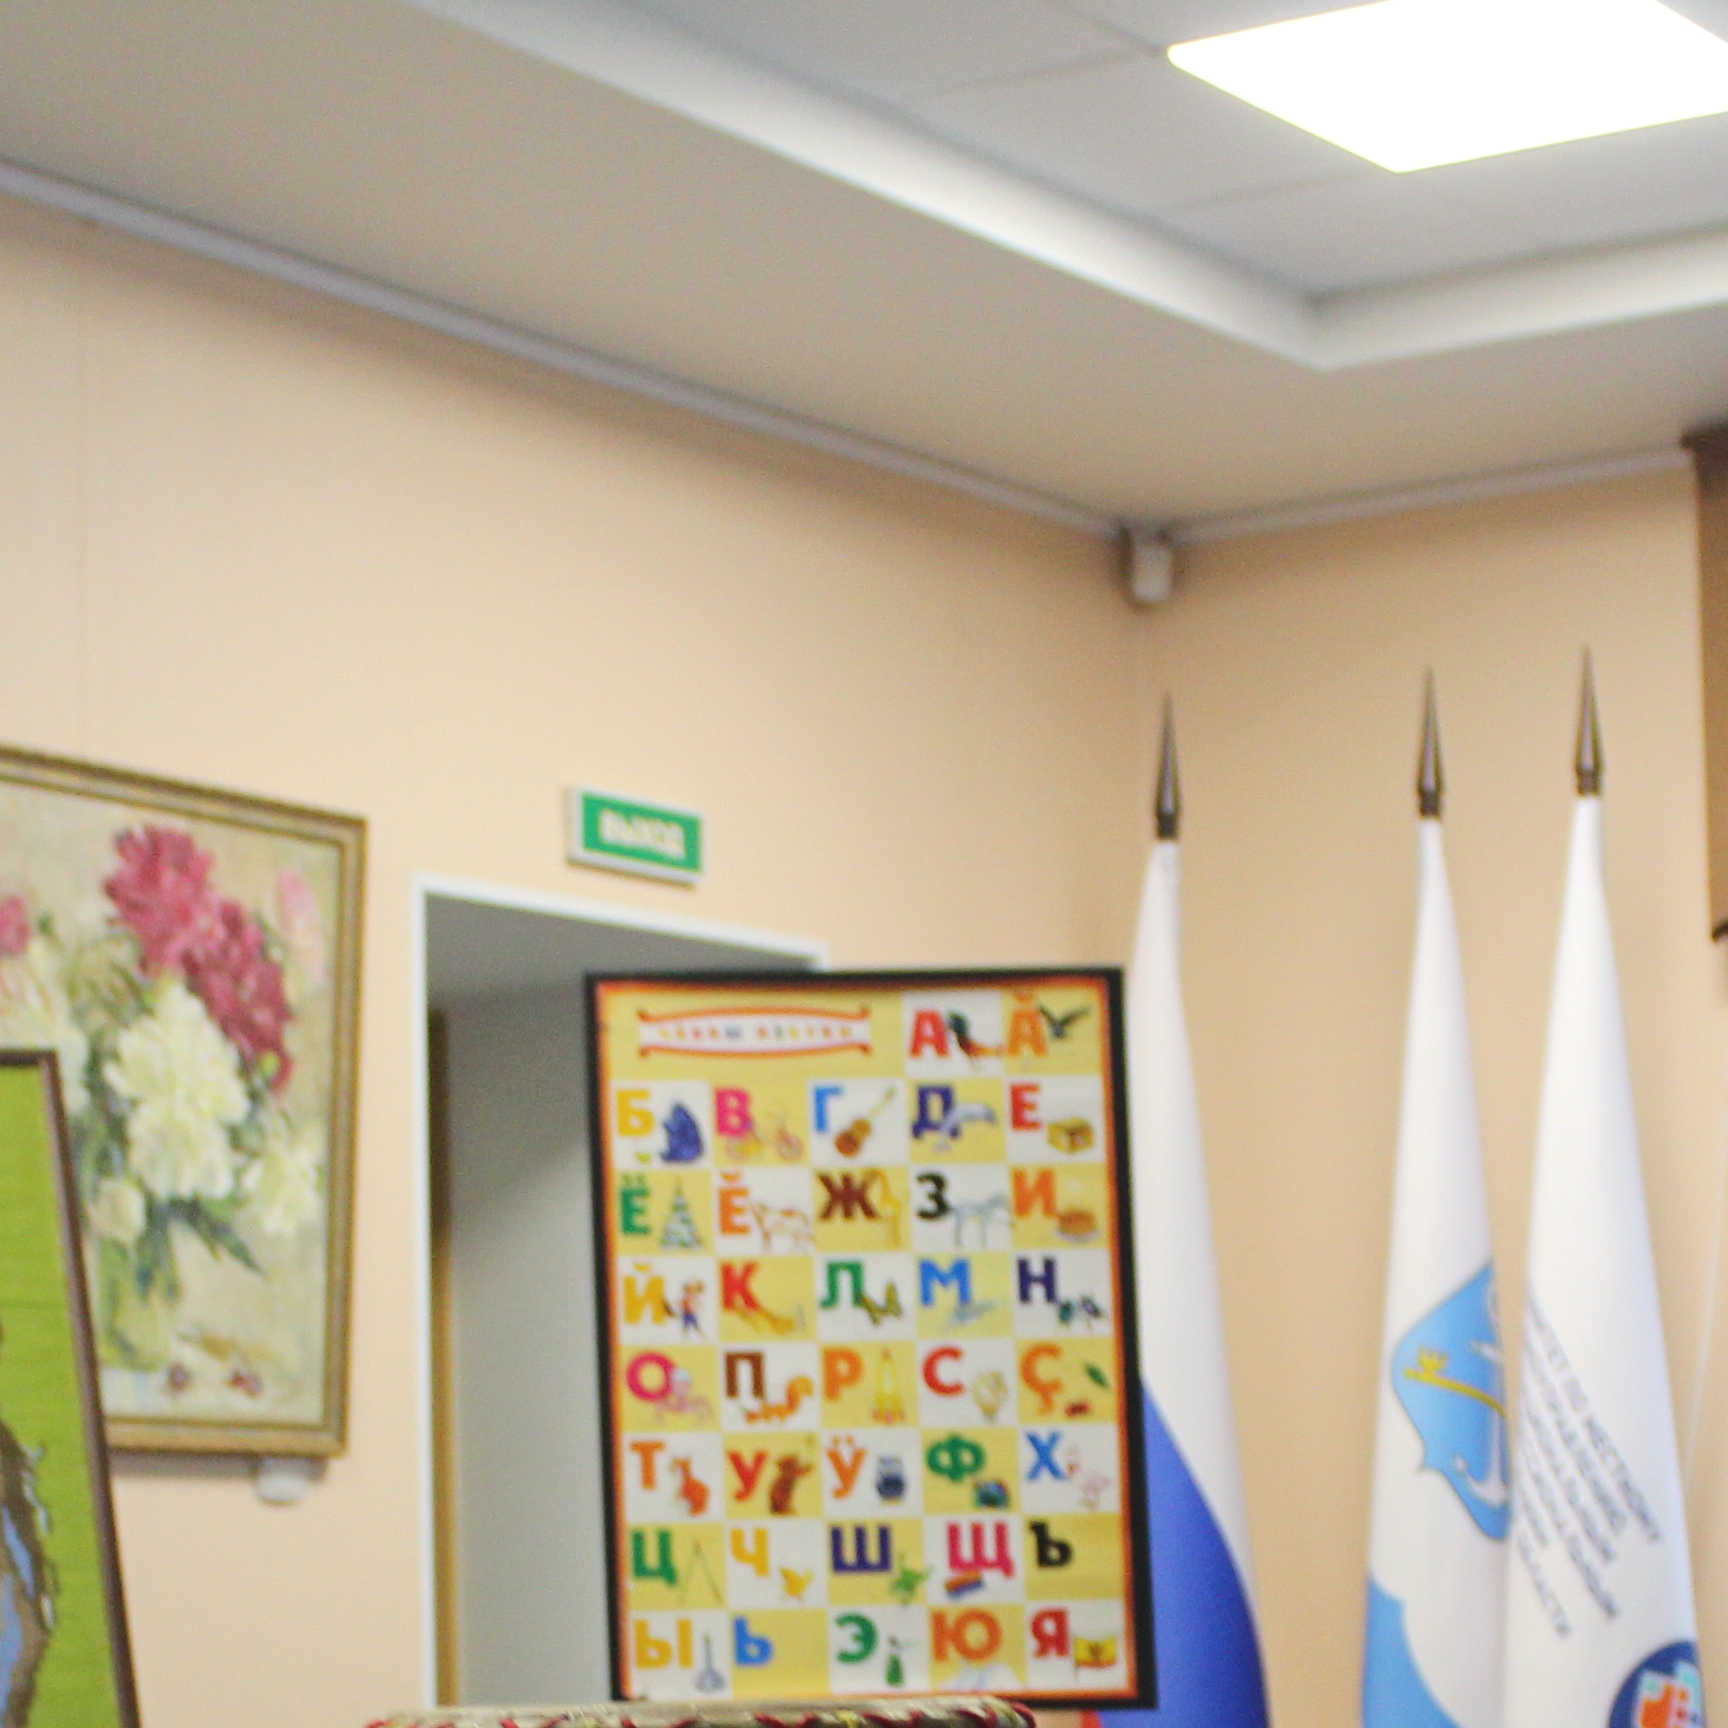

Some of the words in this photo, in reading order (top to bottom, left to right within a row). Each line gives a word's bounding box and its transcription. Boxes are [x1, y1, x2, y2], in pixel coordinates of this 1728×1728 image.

[909, 1008, 952, 1059] А
[615, 1088, 655, 1137] Б
[714, 1086, 752, 1138] В
[812, 1085, 846, 1135] Г
[910, 1083, 962, 1141] Д
[1009, 1082, 1043, 1132] Е
[816, 1173, 880, 1222] Ж
[915, 1170, 953, 1222] З
[1011, 1168, 1058, 1220] И
[623, 1262, 666, 1325] Й
[720, 1260, 762, 1312] К
[820, 1260, 868, 1311] Л
[918, 1257, 973, 1307] М
[1016, 1257, 1058, 1305] Н
[725, 1352, 767, 1399] П
[824, 1348, 866, 1403] Р
[922, 1346, 966, 1397] С
[629, 1441, 667, 1490] Т
[727, 1449, 769, 1502] У
[925, 1432, 987, 1484] Ф
[1025, 1430, 1067, 1481] Х
[631, 1530, 678, 1588] Ц
[730, 1527, 770, 1577] Ч
[830, 1525, 893, 1575] Ш
[945, 1521, 1015, 1579] Щ
[1028, 1520, 1074, 1570] Ъ
[633, 1617, 695, 1670] Ы
[733, 1615, 775, 1668] Ь
[835, 1612, 878, 1664] Э
[930, 1607, 1003, 1662] Ю
[1029, 1607, 1071, 1658] Я
